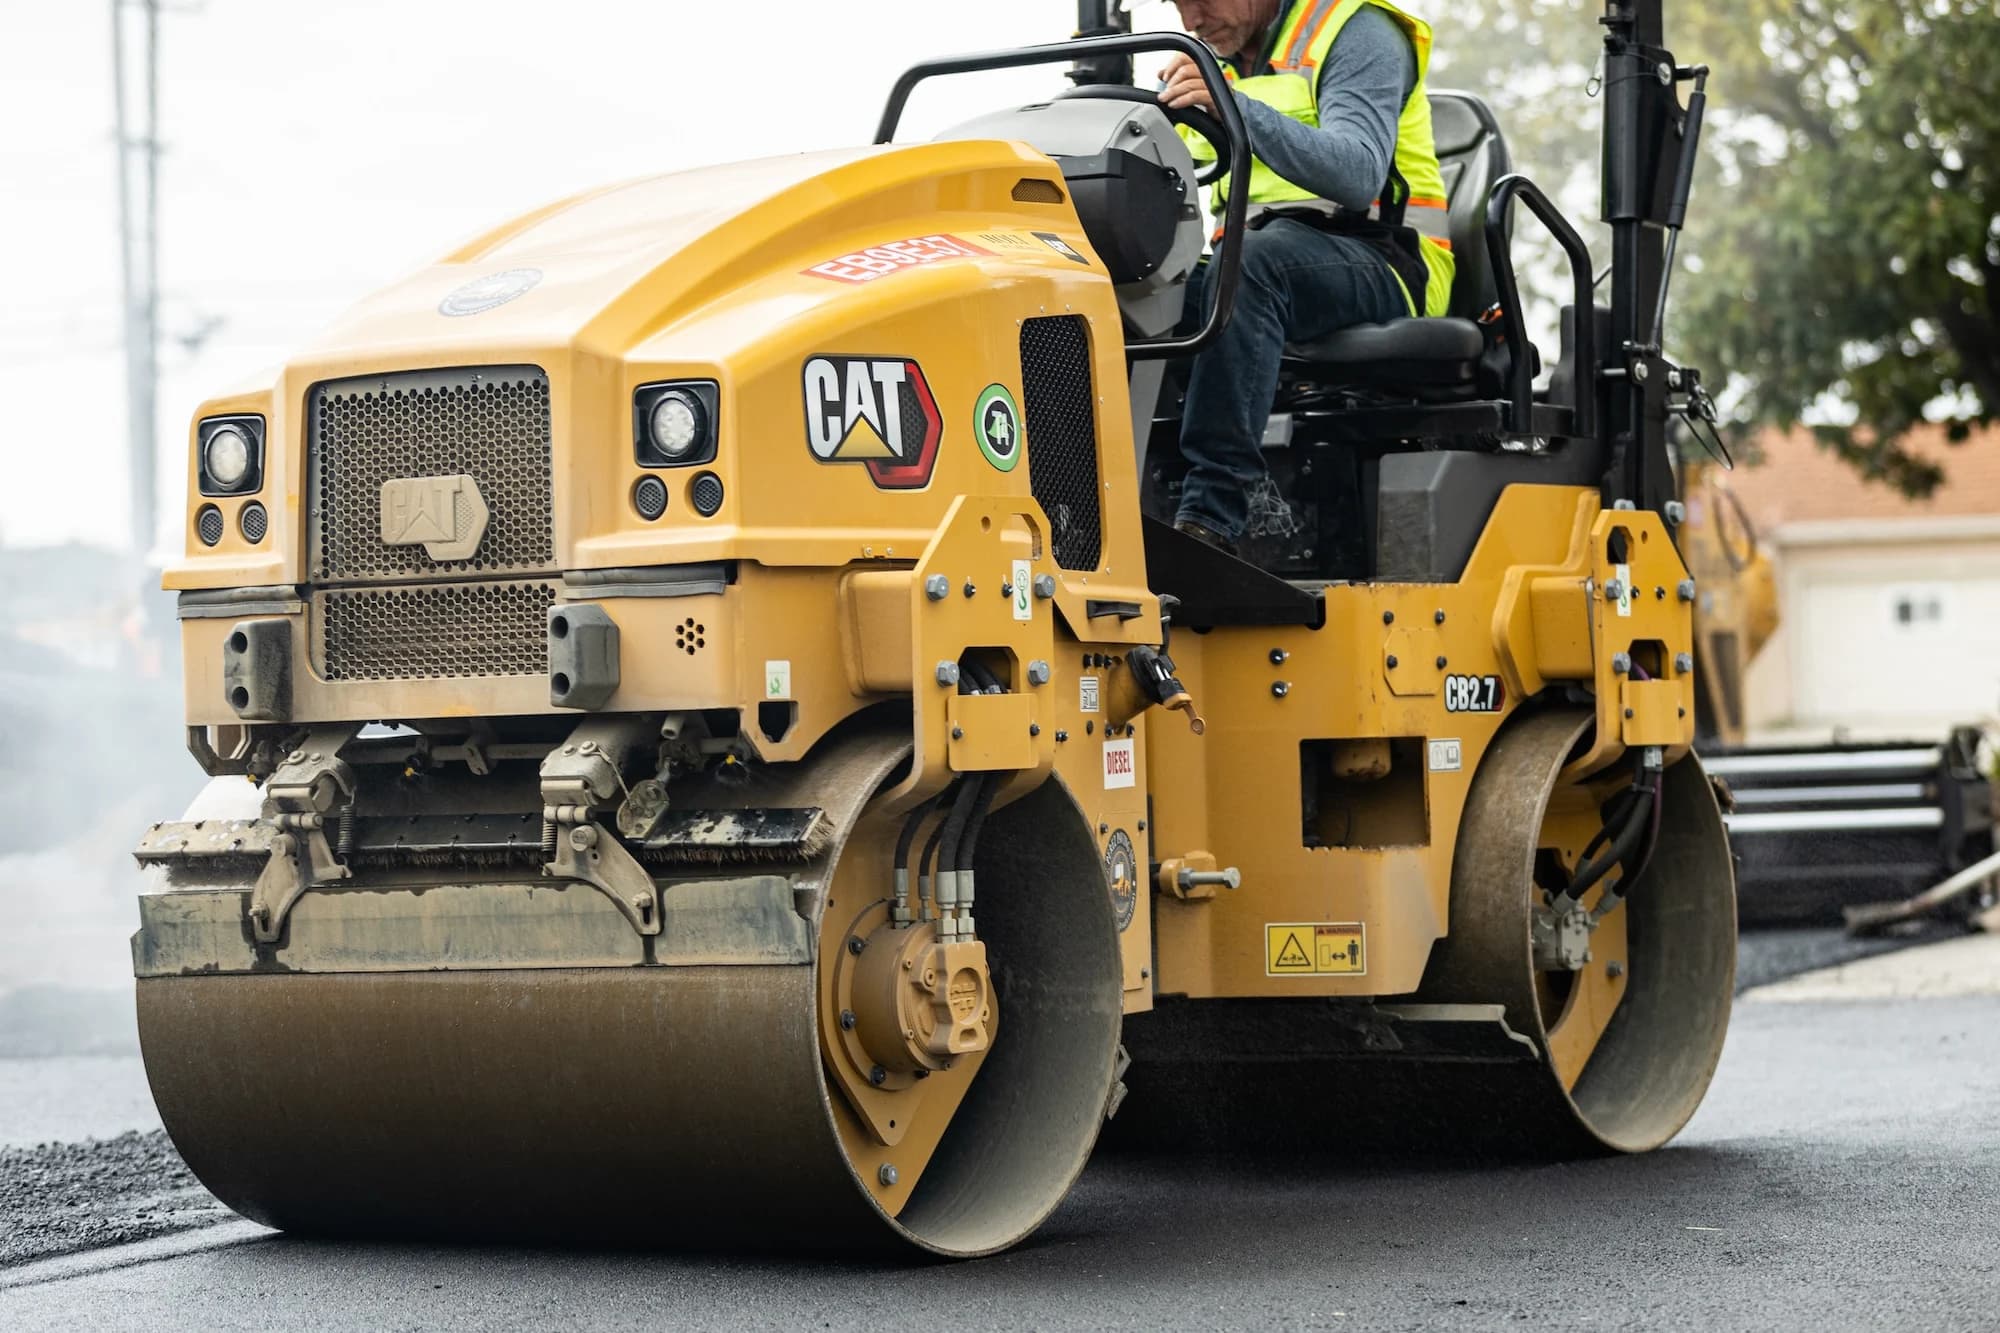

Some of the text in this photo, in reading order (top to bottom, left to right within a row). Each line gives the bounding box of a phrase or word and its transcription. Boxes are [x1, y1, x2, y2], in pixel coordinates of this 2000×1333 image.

[810, 235, 977, 281] EB9E37
[804, 358, 906, 458] CAT
[382, 476, 461, 543] CAT
[1445, 675, 1496, 711] CB2.7
[1106, 750, 1131, 775] DIESEL
